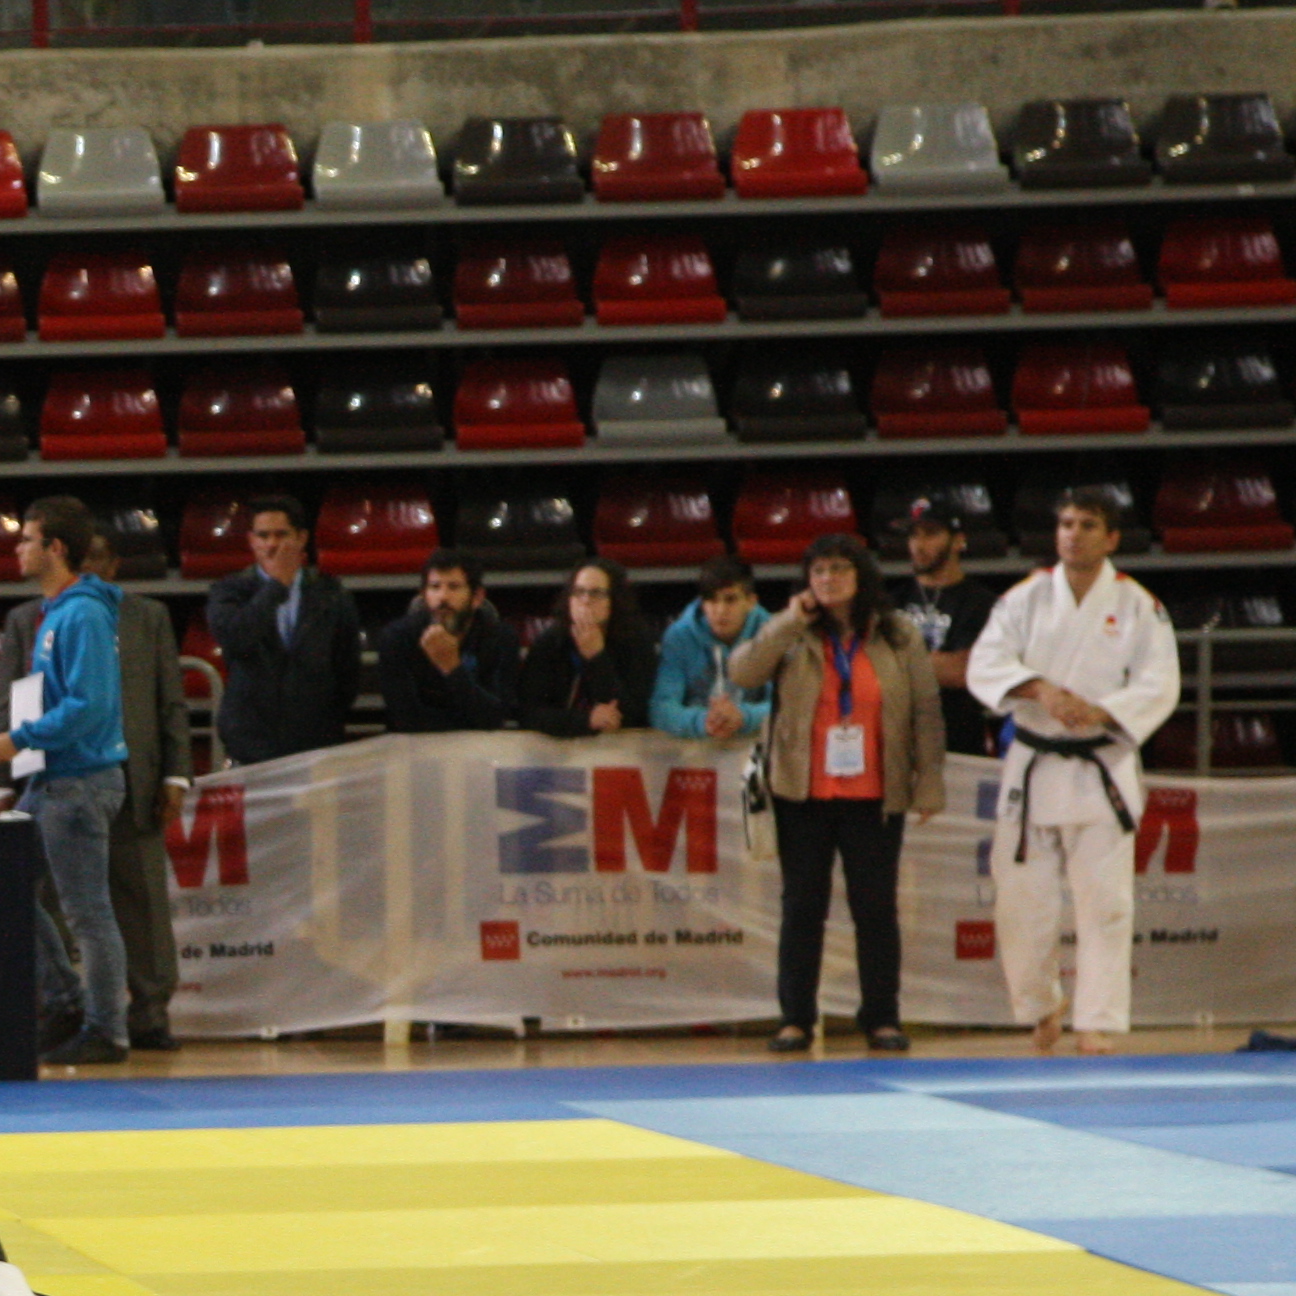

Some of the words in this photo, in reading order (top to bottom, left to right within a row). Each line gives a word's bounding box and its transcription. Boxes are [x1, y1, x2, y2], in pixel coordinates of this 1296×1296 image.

[526, 930, 637, 946] Comunidad
[644, 930, 668, 945] de
[675, 928, 744, 945] Madrid
[1151, 927, 1219, 943] Madrid
[181, 944, 203, 959] de
[209, 941, 274, 957] Madrid
